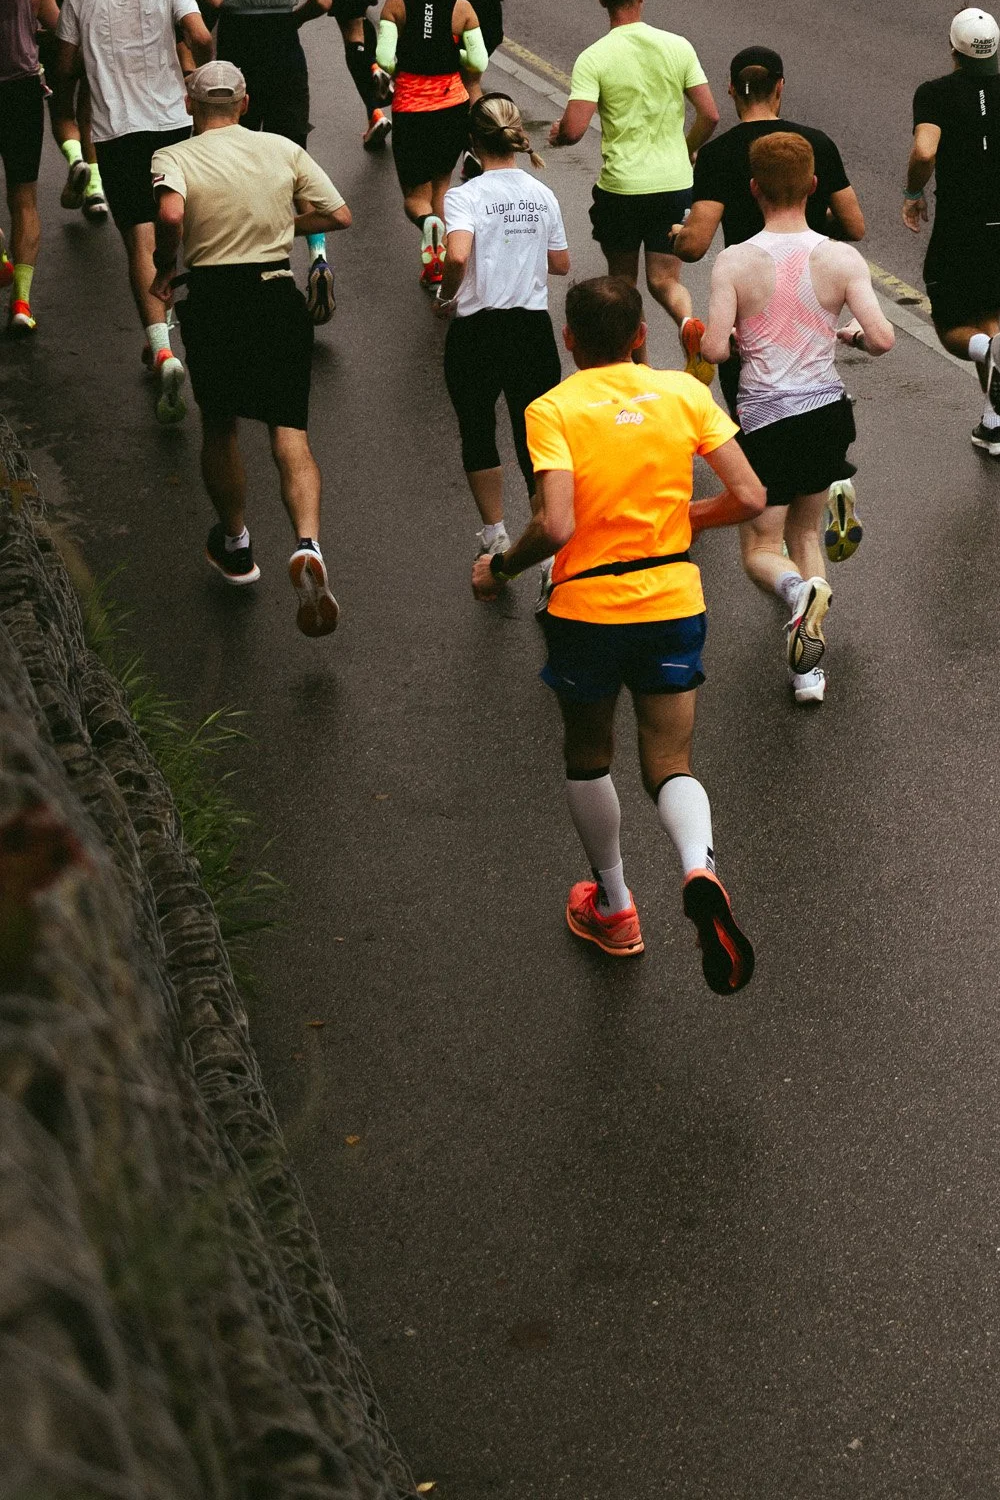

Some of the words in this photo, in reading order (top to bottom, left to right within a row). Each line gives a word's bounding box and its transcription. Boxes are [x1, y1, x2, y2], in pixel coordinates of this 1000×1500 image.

[423, 3, 434, 40] TERREX
[485, 202, 515, 215] Liigun
[503, 214, 539, 223] suunas
